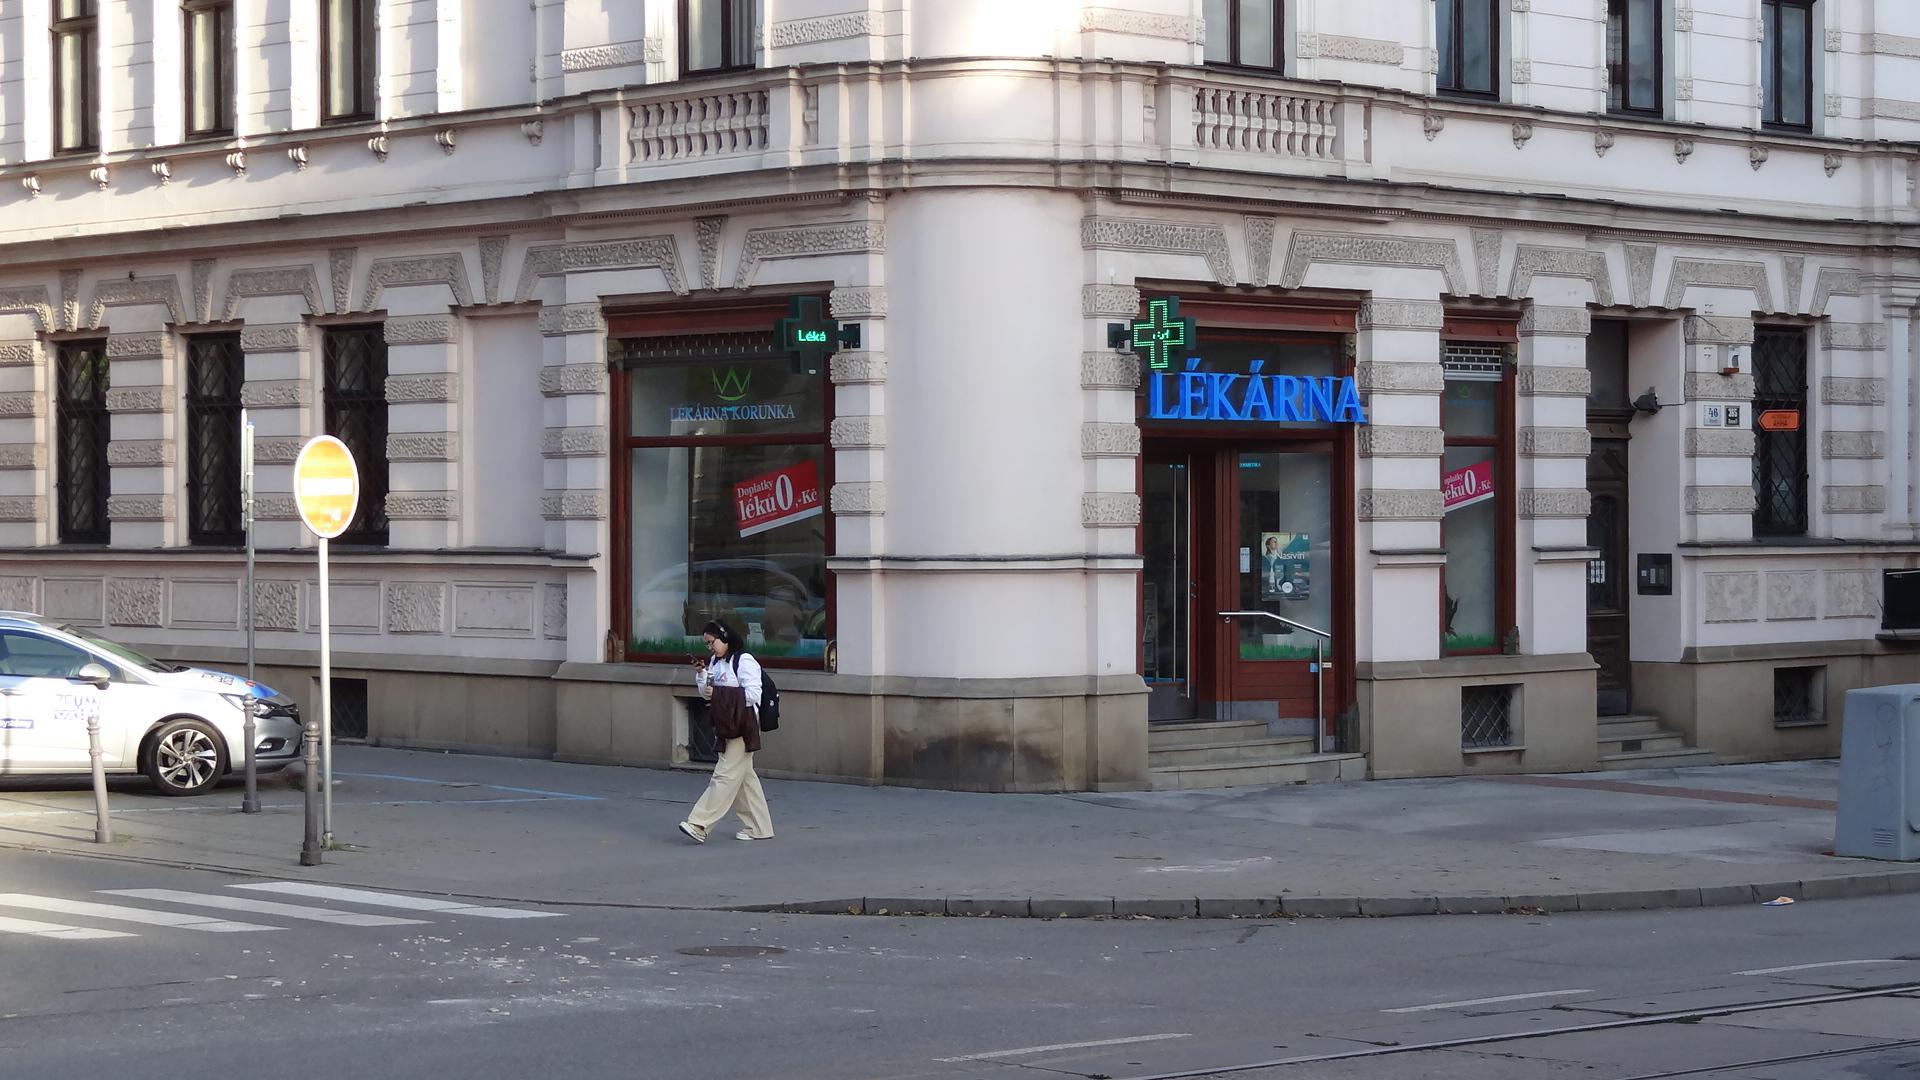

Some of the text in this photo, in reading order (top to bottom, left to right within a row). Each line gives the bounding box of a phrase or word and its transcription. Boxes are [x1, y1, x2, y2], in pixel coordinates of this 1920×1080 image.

[798, 329, 826, 342] Léká
[1151, 358, 1367, 422] LÉKÁRNA
[670, 403, 795, 421] LÉKÁRNA KORUNKA
[1708, 407, 1719, 418] 46
[737, 479, 773, 498] Doplatky
[1445, 483, 1465, 500] éků
[739, 494, 777, 520] léků
[1275, 551, 1305, 560] Nasivin
